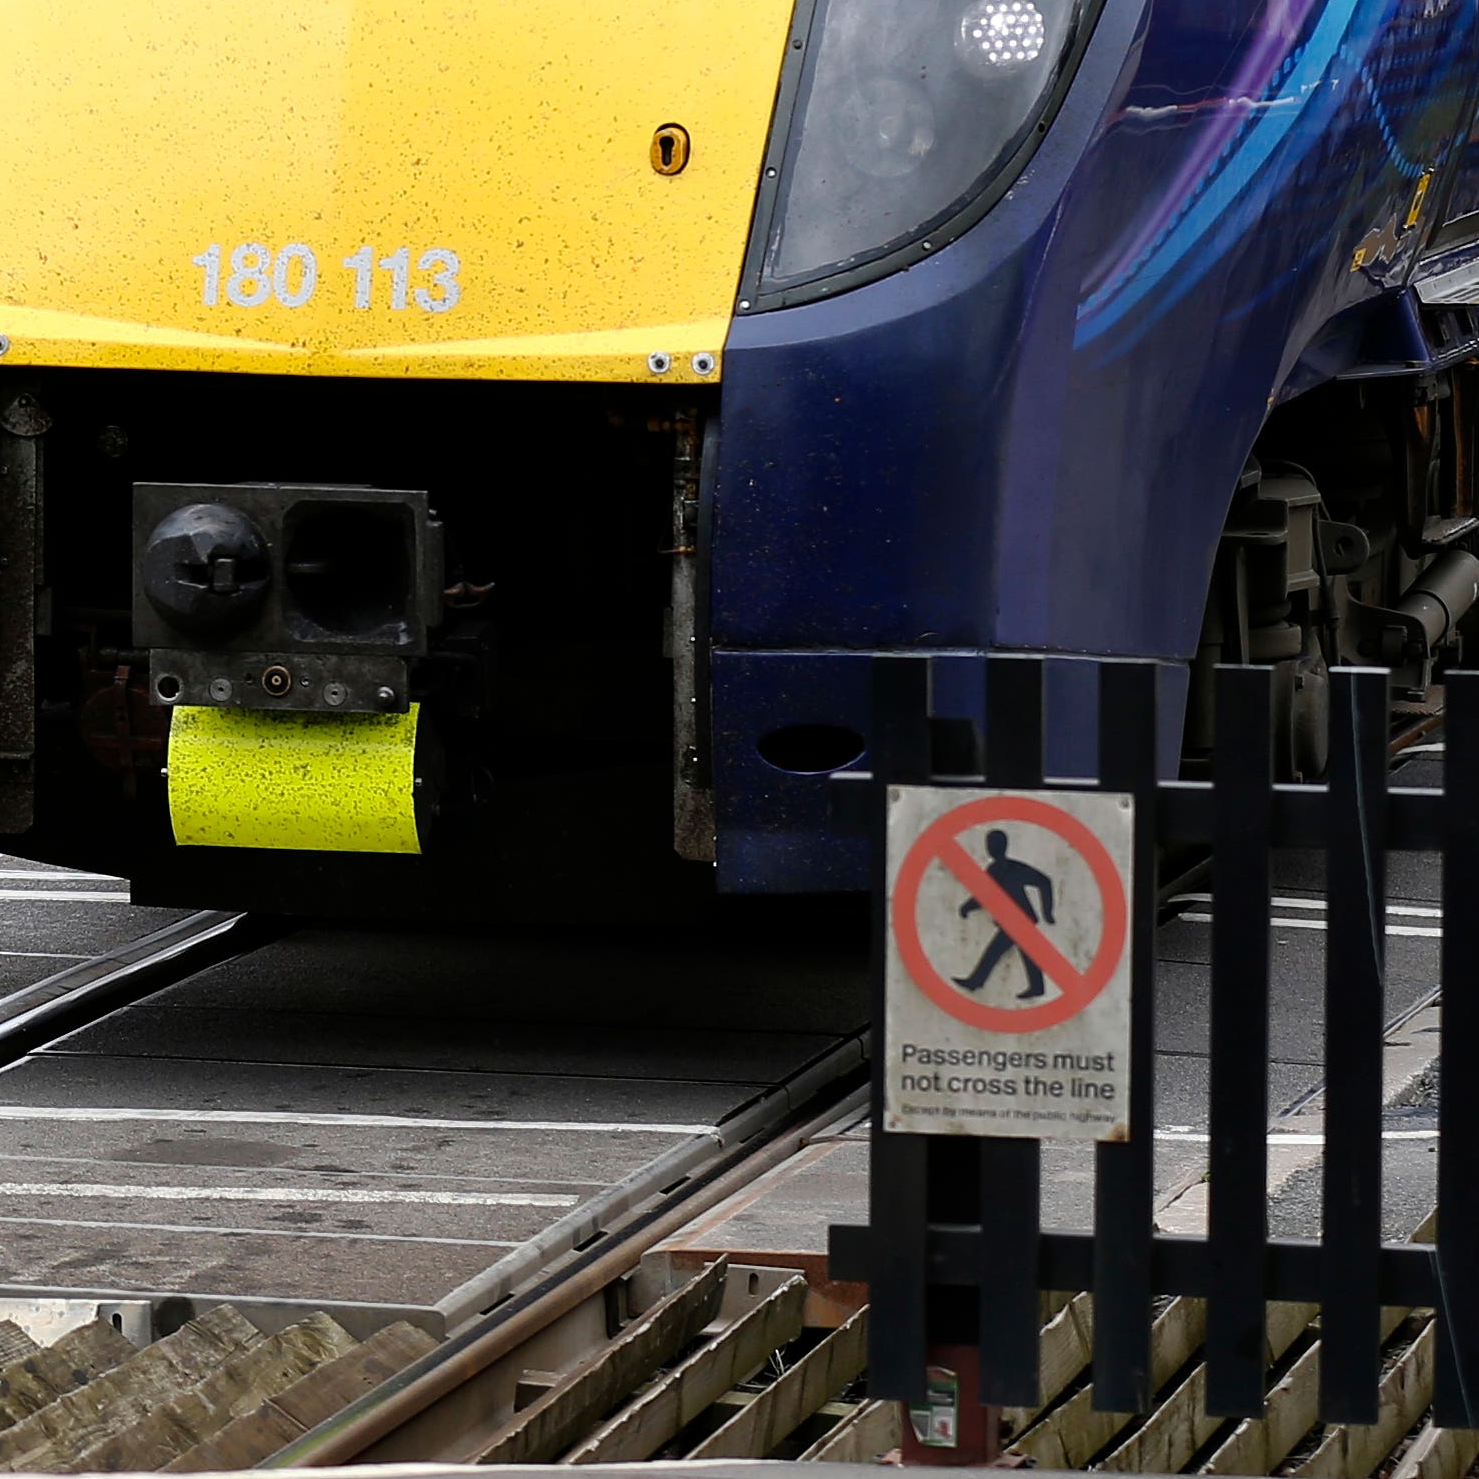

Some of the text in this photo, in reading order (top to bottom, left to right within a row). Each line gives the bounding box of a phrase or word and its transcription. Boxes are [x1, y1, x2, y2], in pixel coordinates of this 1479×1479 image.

[192, 242, 461, 313] 180 113
[902, 1043, 1115, 1072] Passengers must
[901, 1071, 1115, 1100] not cross the line
